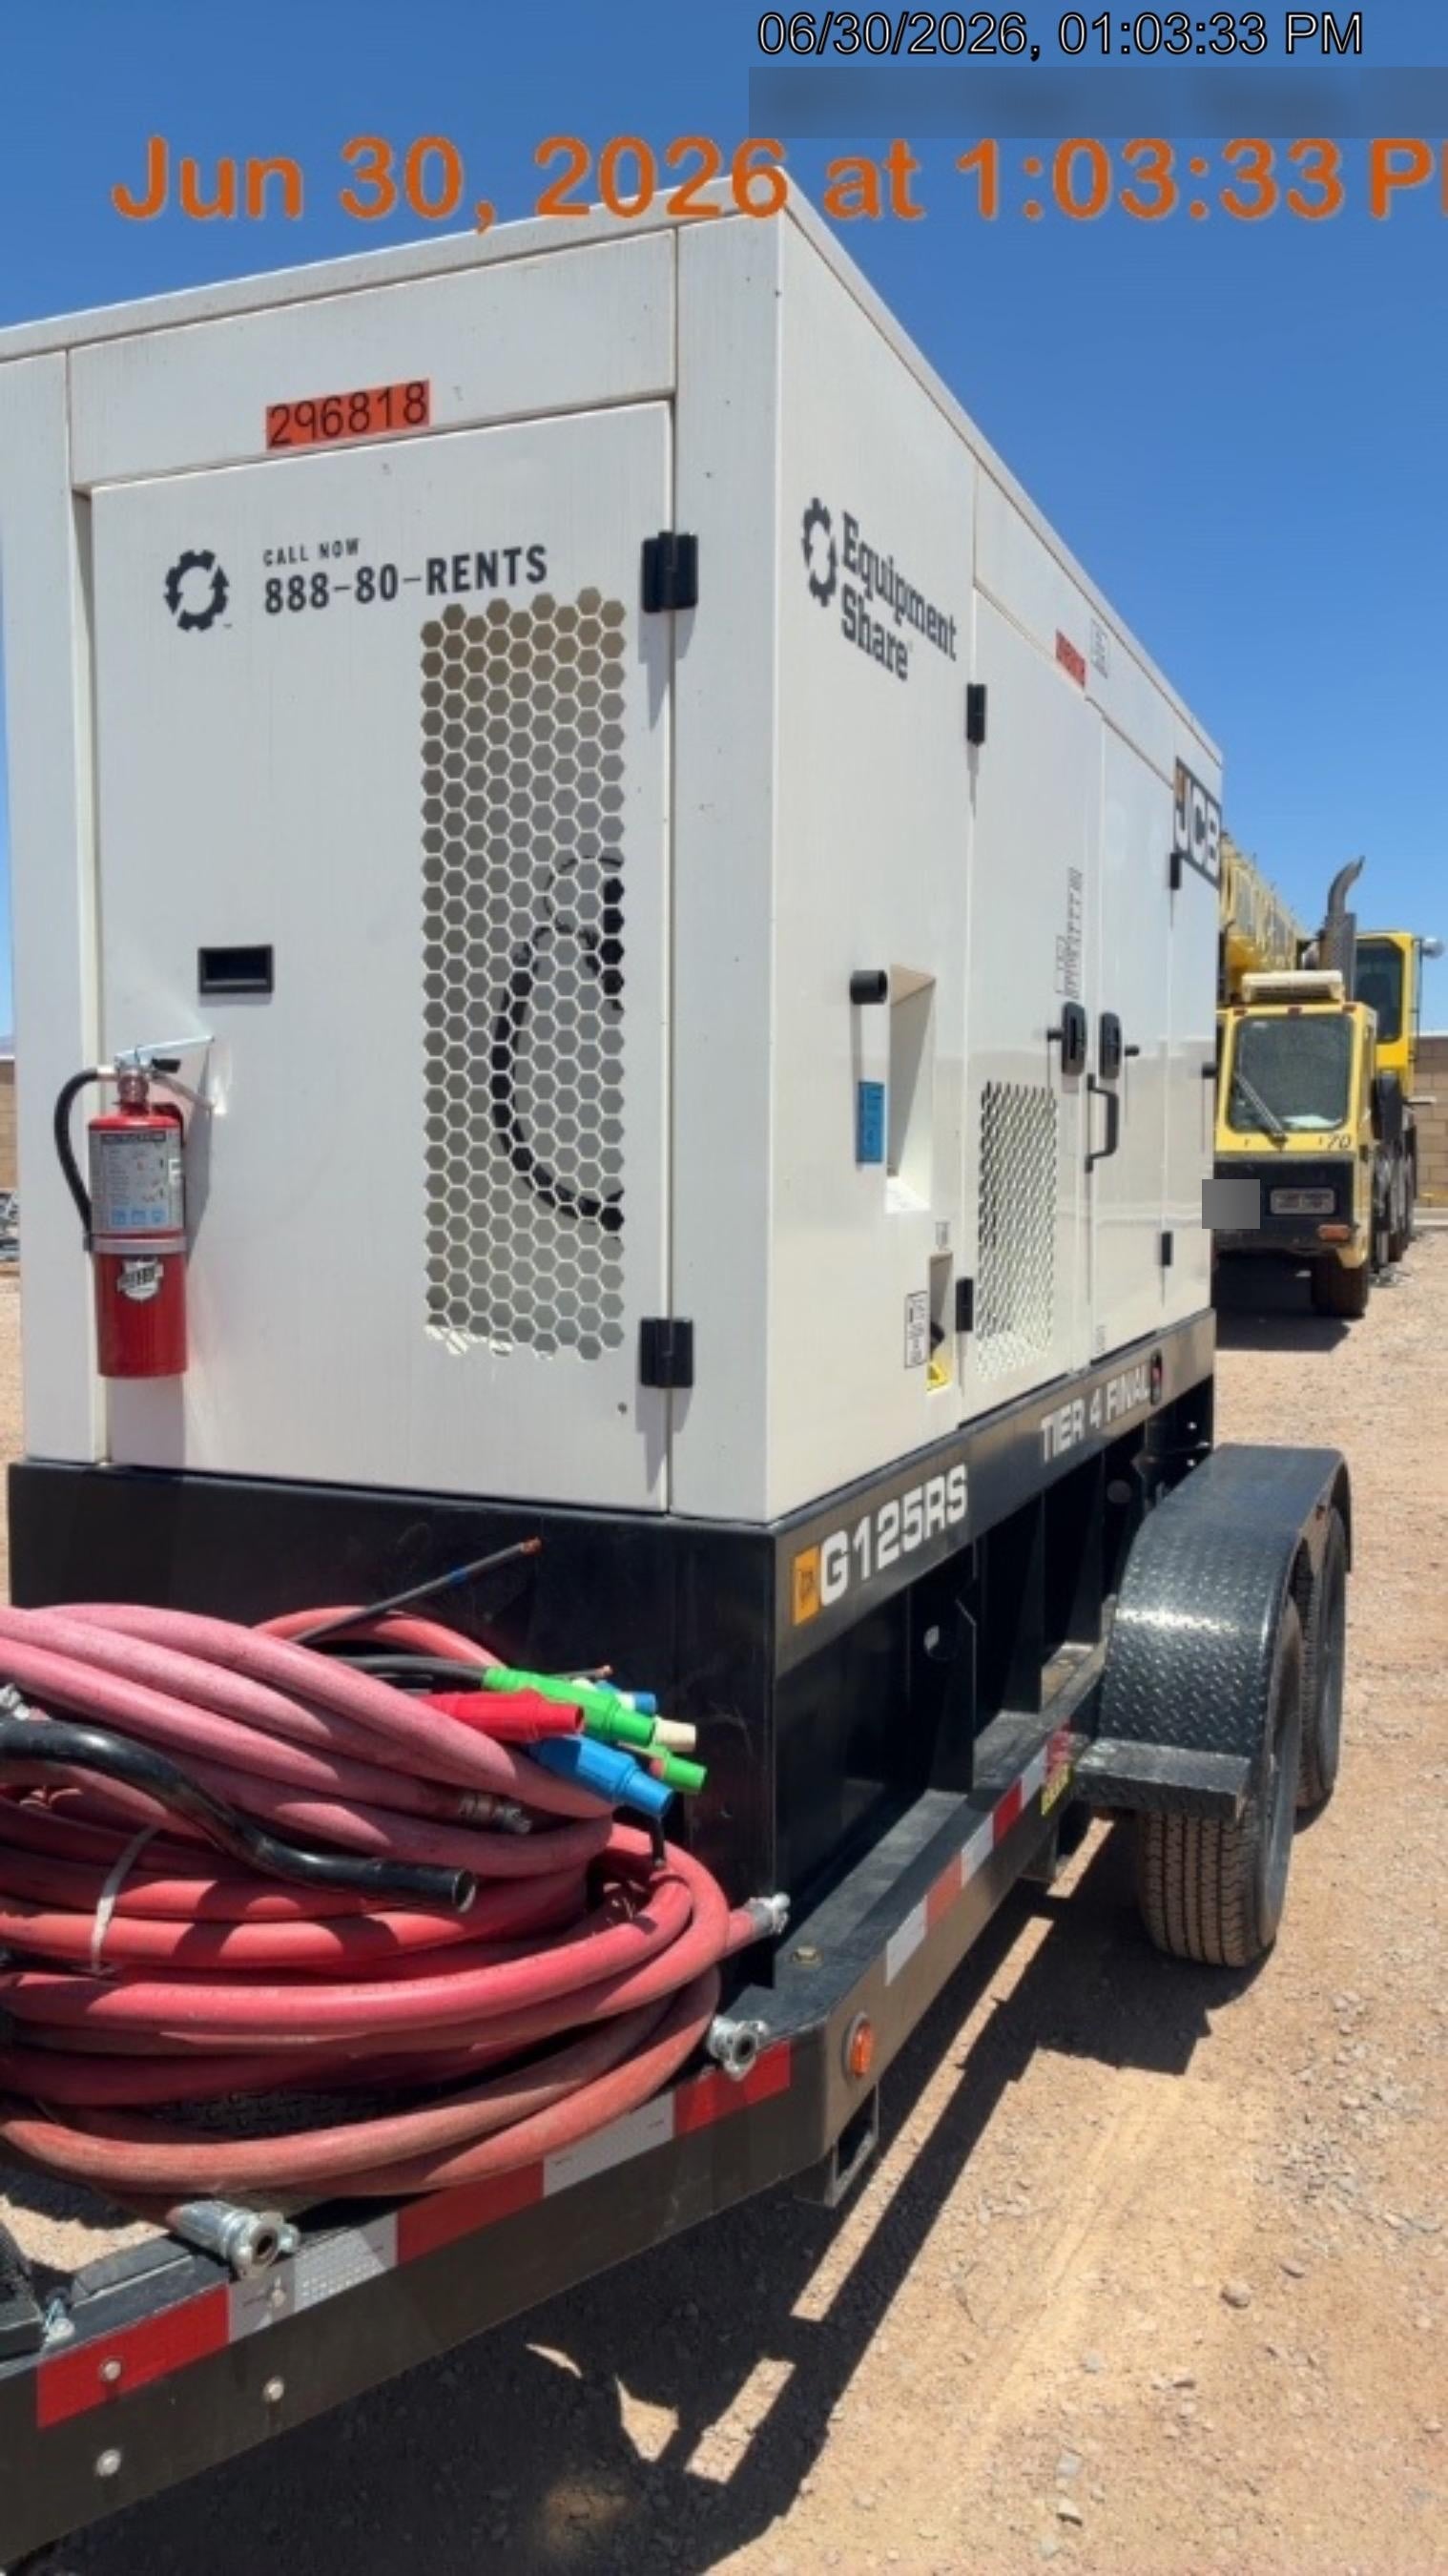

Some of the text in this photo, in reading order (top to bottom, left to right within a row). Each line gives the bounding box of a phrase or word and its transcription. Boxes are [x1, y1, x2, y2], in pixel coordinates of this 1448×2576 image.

[270, 382, 427, 447] 296818
[262, 537, 361, 567] CALL NOW
[264, 543, 548, 615] 888-80-RENTS
[842, 509, 957, 662] Equipment
[841, 582, 908, 681] Share
[1041, 1364, 1149, 1465] TIER 4 FINAL
[820, 1463, 968, 1608] G125RS
